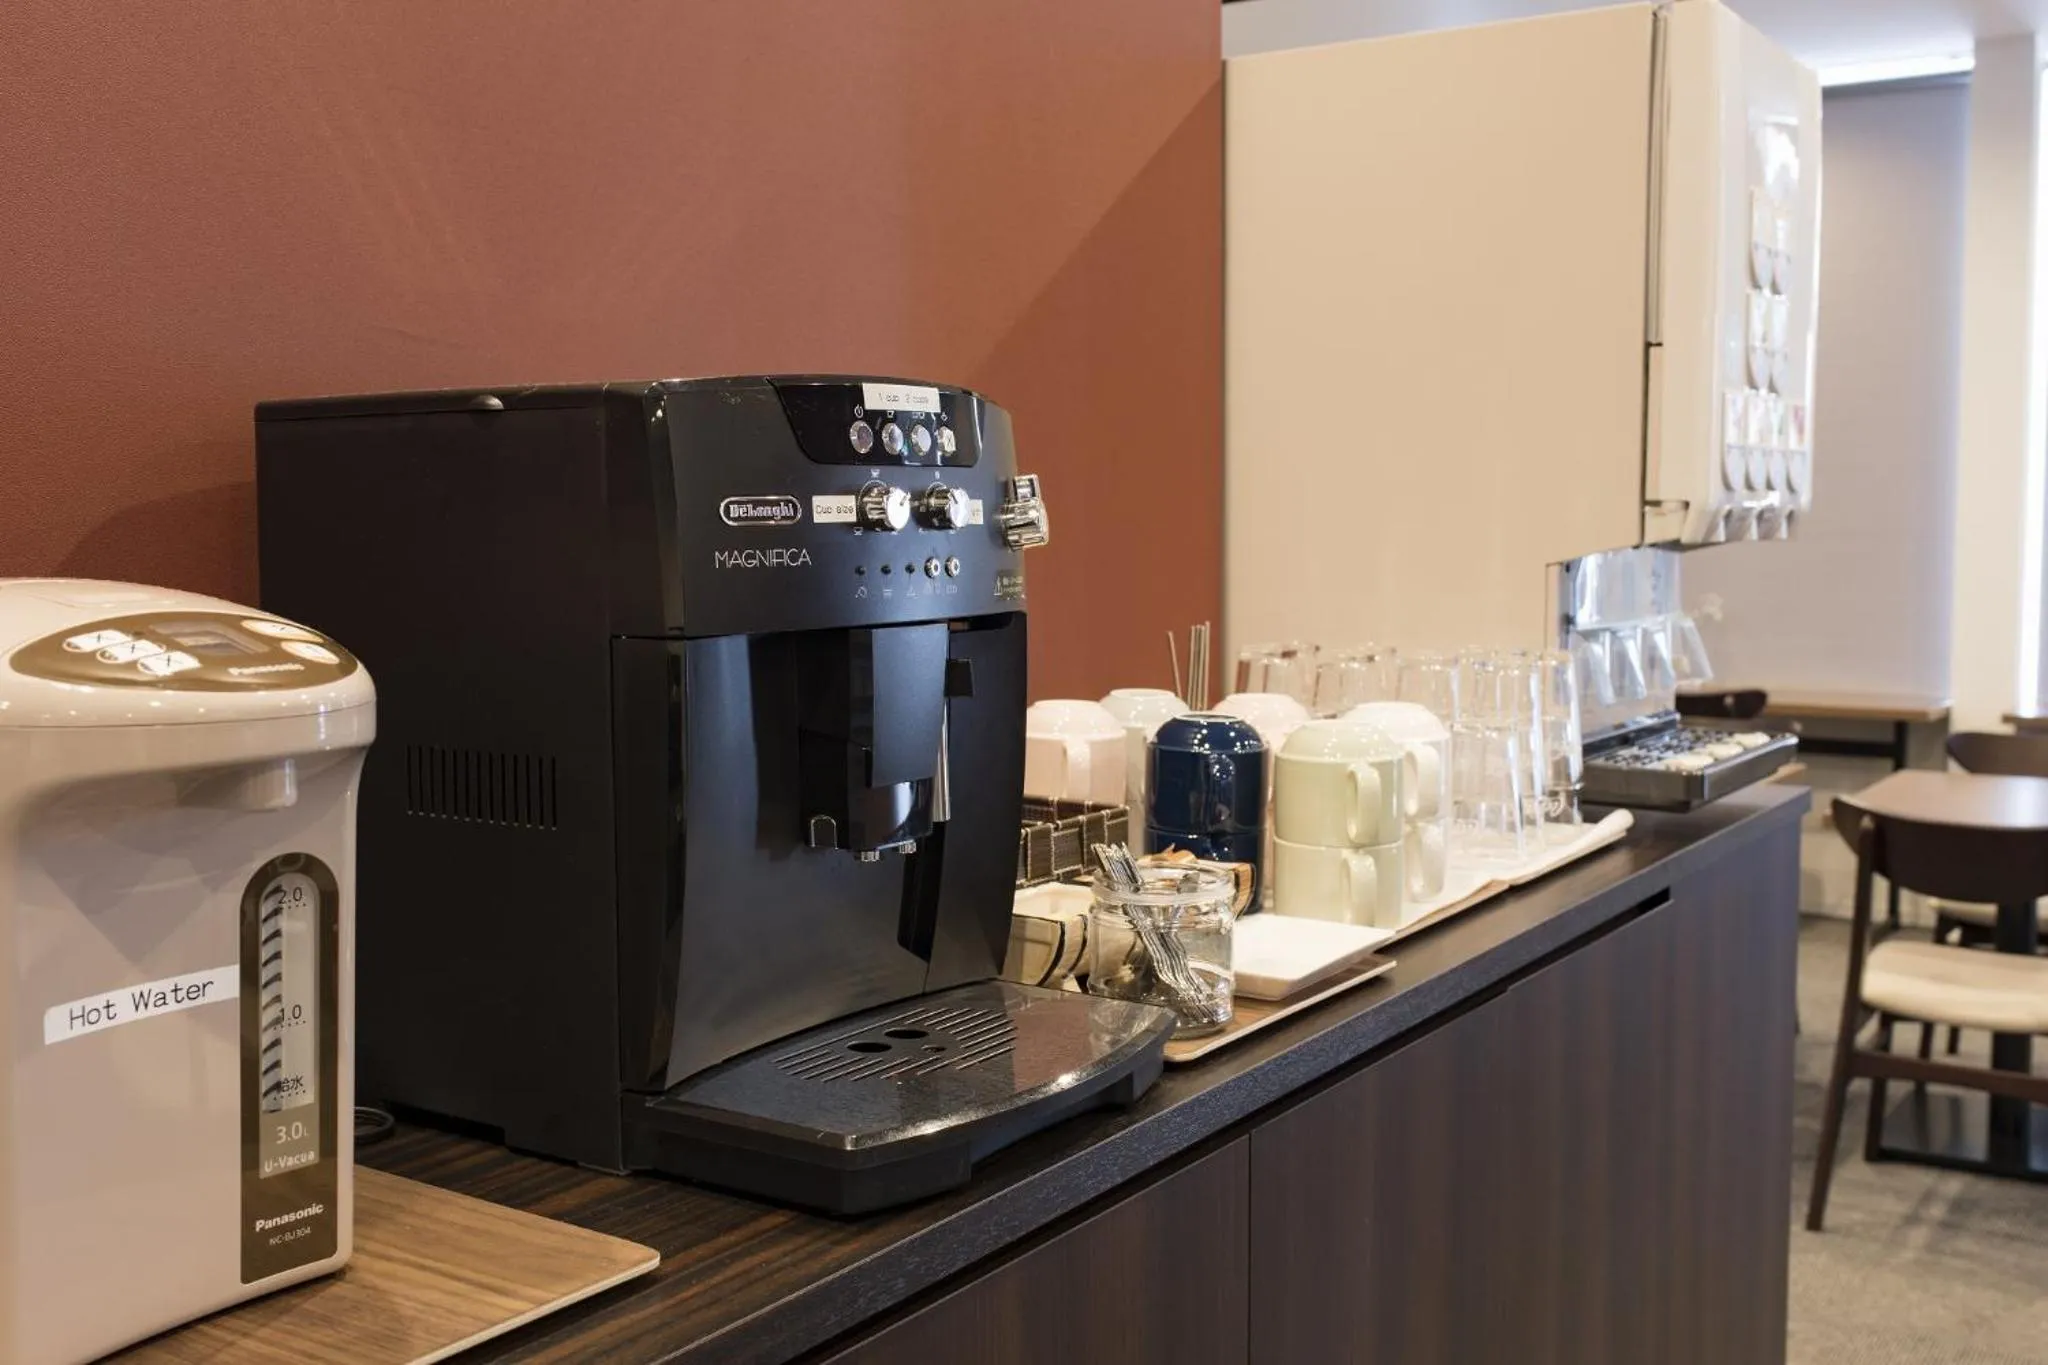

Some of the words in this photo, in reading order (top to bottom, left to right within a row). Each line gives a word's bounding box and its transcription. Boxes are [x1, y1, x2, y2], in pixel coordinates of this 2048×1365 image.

[714, 547, 812, 569] MAGNIFICA
[69, 999, 117, 1030] Hot
[131, 980, 214, 1013] Water
[255, 1203, 324, 1232] Panasonic
